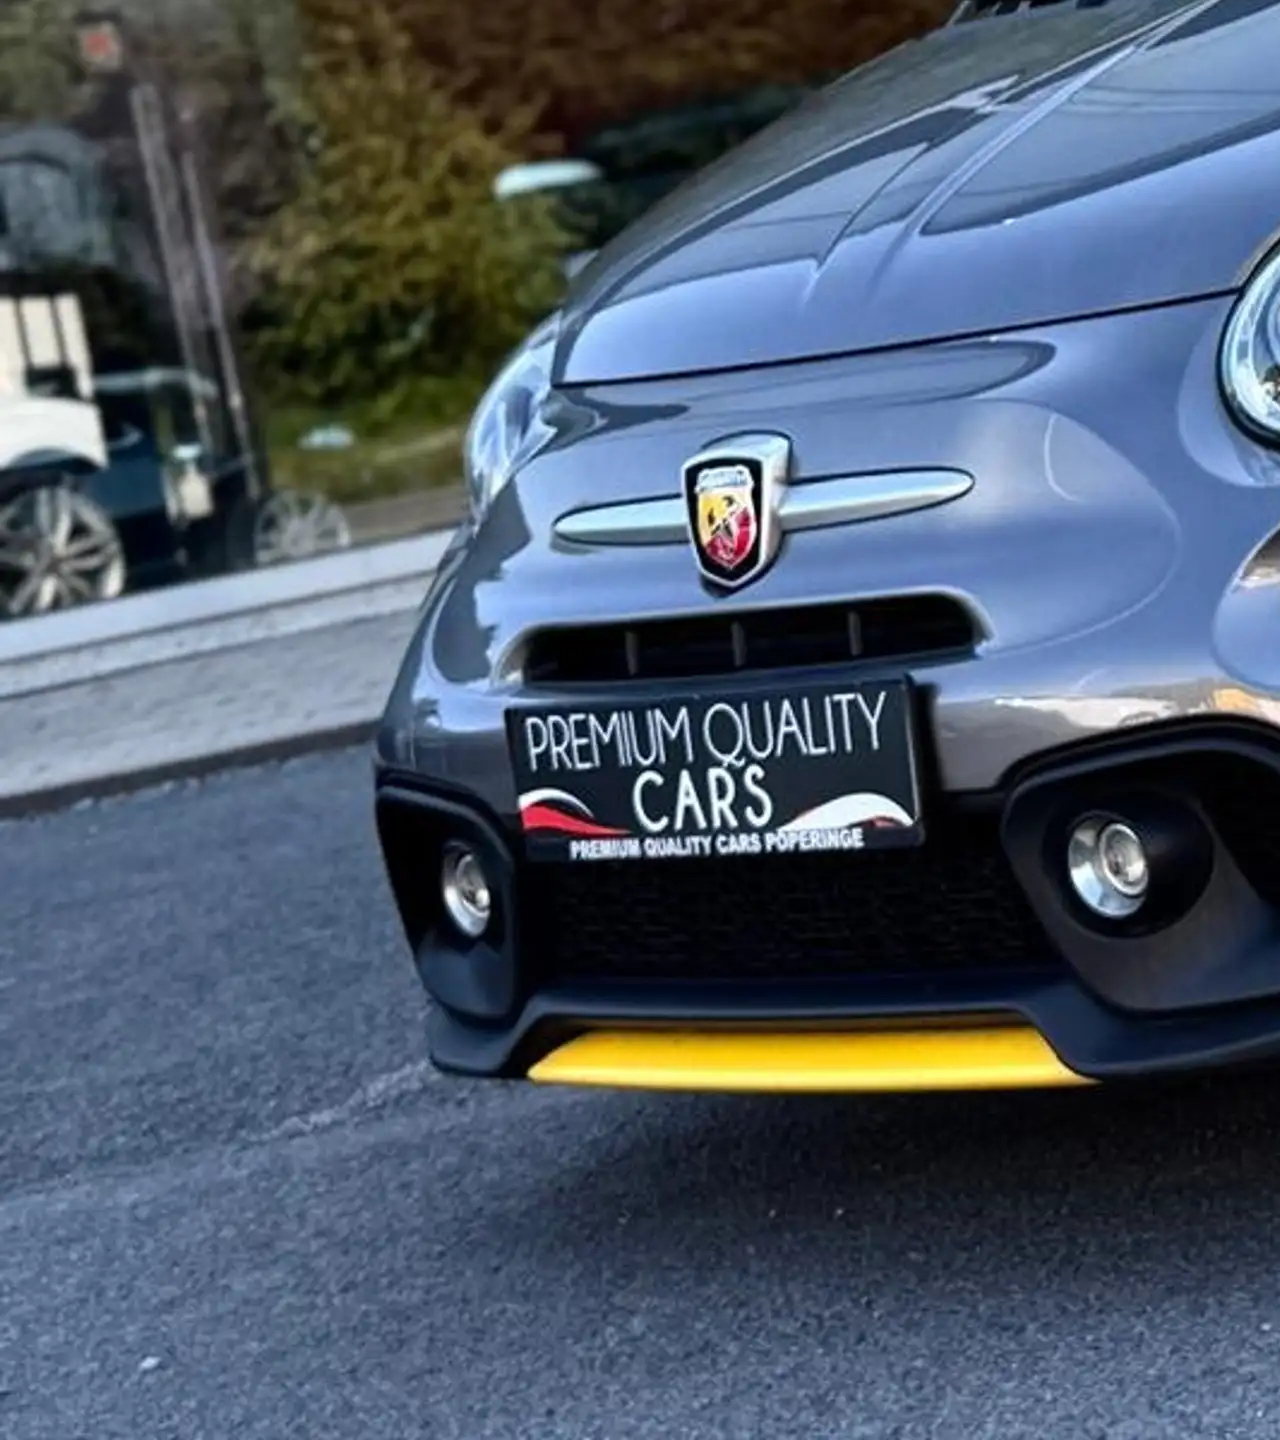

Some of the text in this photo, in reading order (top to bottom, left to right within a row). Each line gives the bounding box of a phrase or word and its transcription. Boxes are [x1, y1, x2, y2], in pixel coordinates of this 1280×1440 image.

[526, 691, 887, 772] PREMIUM QUALITY
[633, 764, 773, 834] CARS
[570, 827, 866, 860] PREMIUM QUALITY CARS POPERINGE
